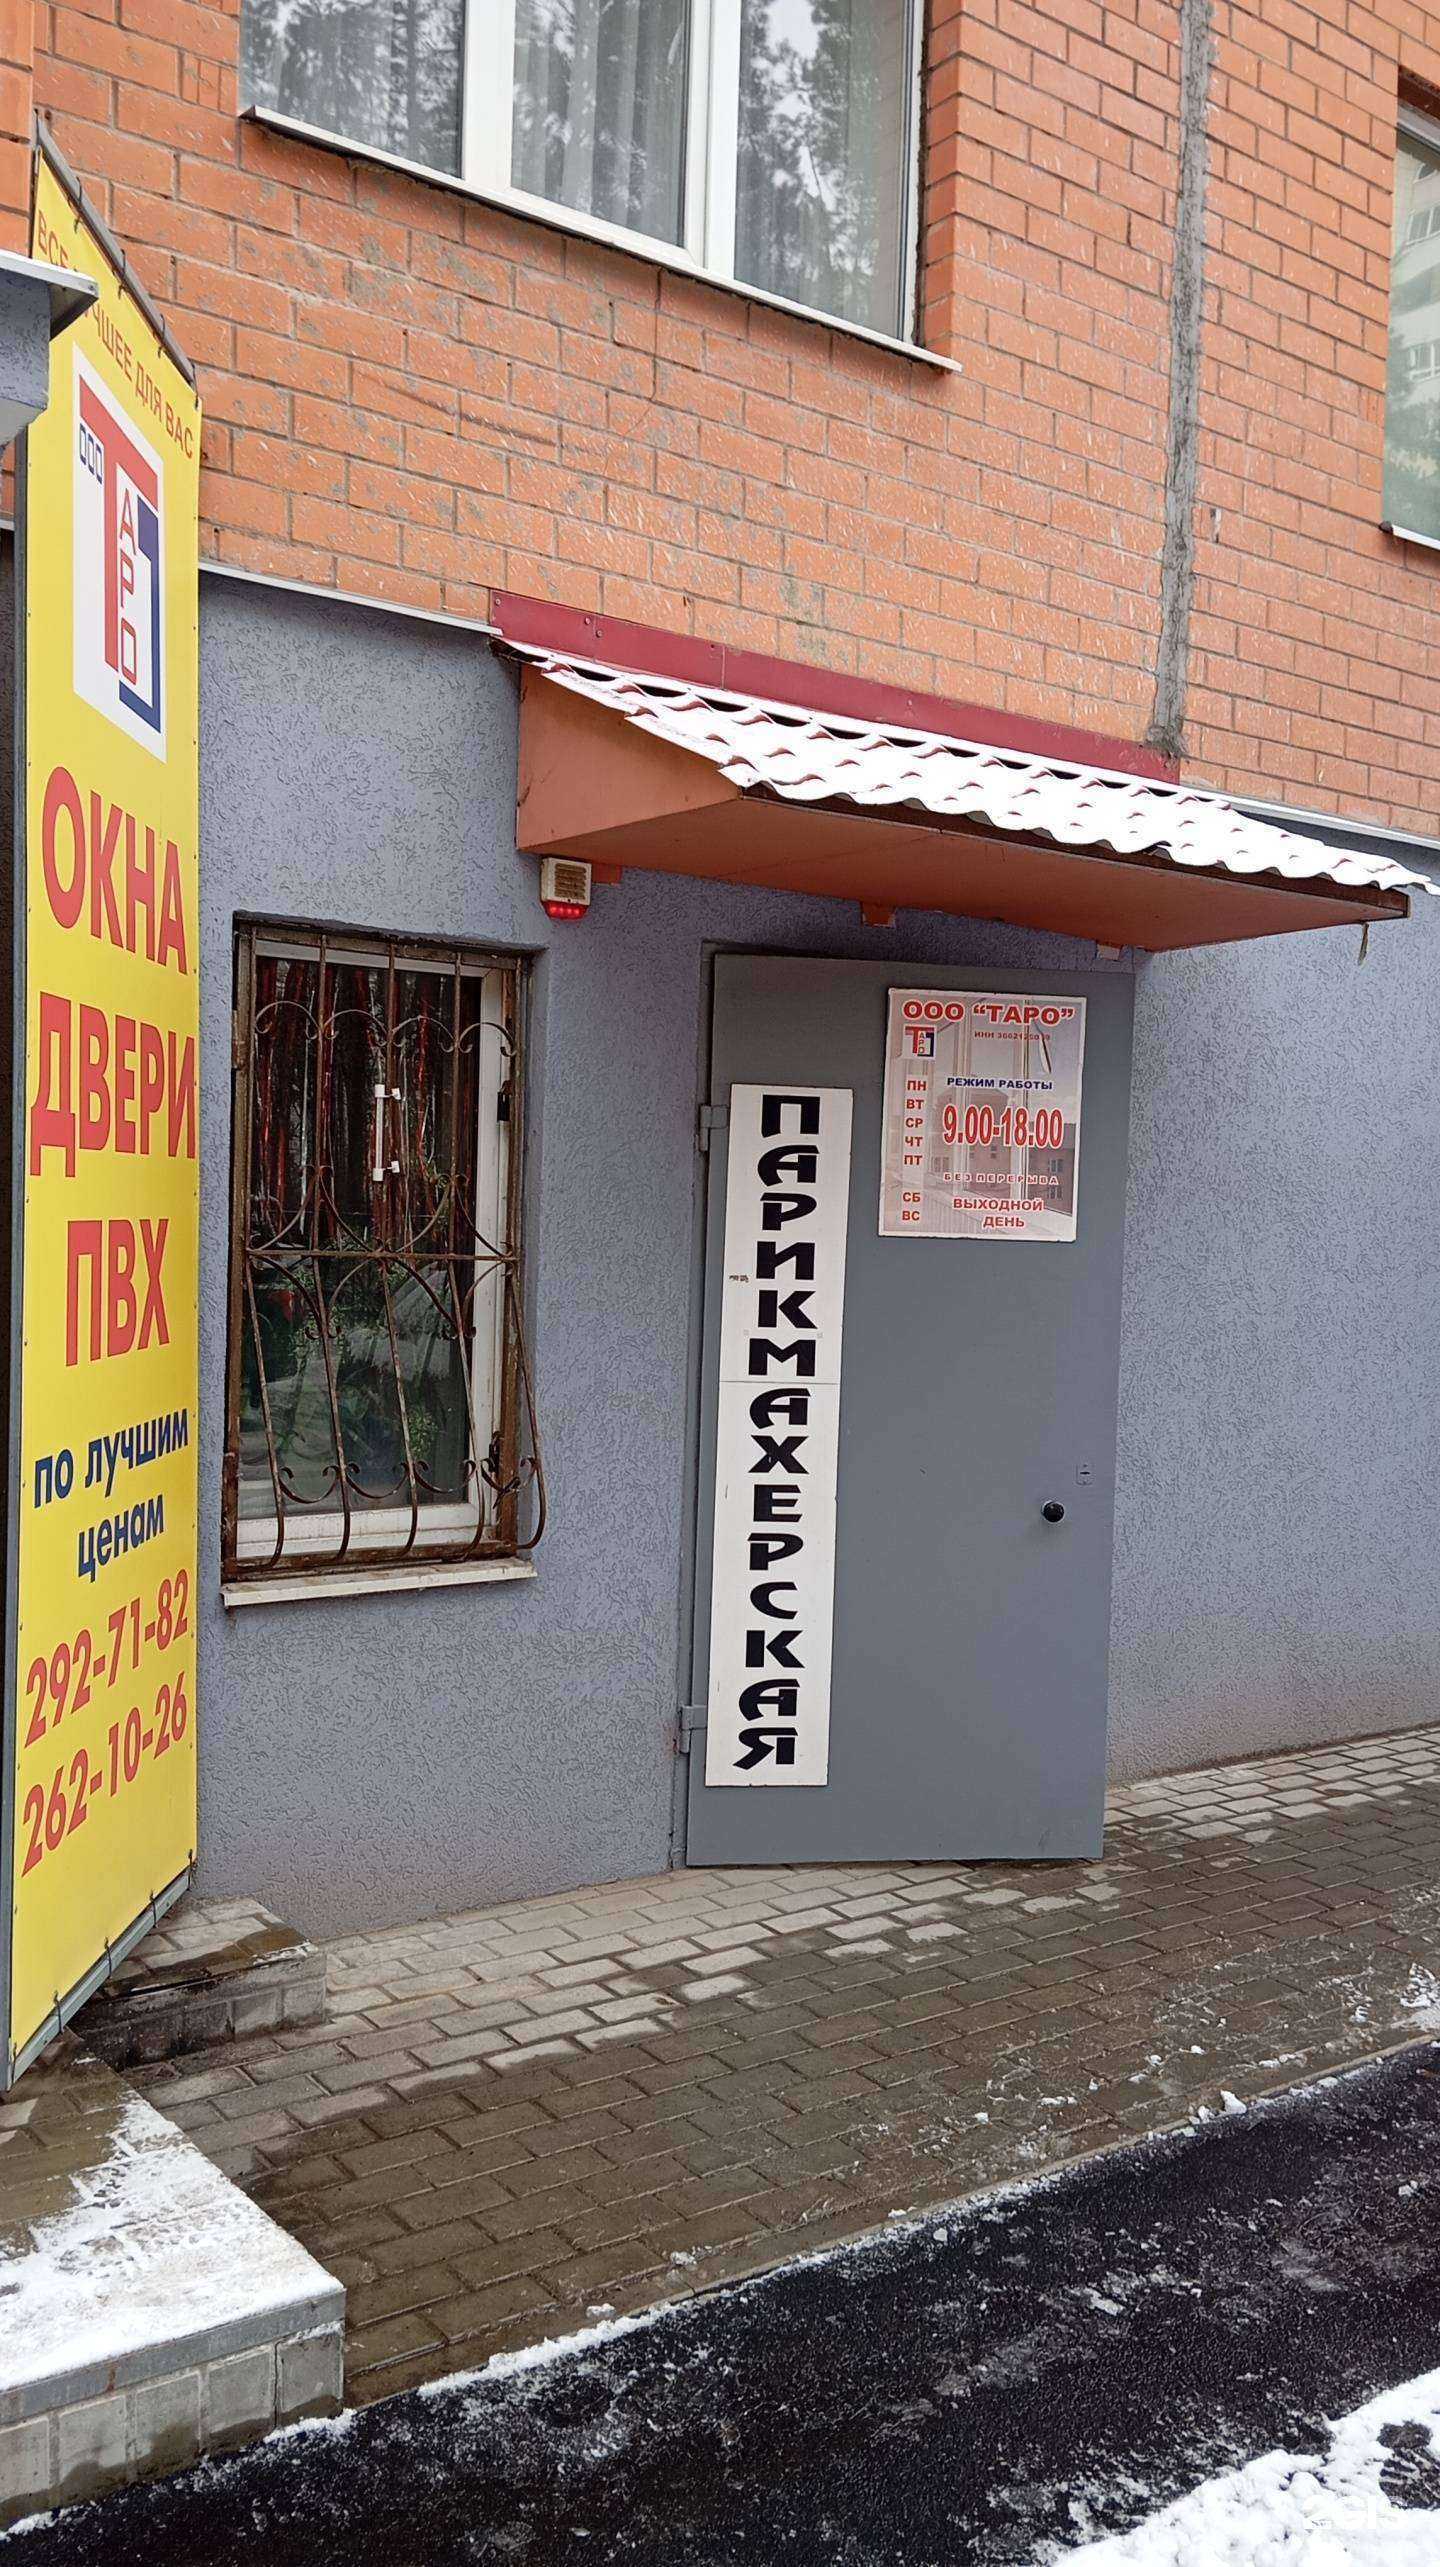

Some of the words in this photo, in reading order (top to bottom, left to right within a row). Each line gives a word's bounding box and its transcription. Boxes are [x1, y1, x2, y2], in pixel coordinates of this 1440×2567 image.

[84, 301, 132, 382] ЧШЕЕ
[136, 361, 162, 423] ДЛЯ
[166, 402, 194, 460] ВАС
[80, 422, 104, 485] ООО
[42, 766, 187, 974] ОКНА
[903, 1001, 964, 1021] ООО
[30, 991, 196, 1178] ДВЕРИ
[907, 1079, 927, 1091] ПН
[947, 1077, 994, 1089] РЕЖИМ
[998, 1079, 1053, 1090] РАБОТЫ
[906, 1099, 924, 1110] ВТ
[905, 1117, 923, 1128] СР
[943, 1104, 1063, 1148] 9.00-18.00
[905, 1136, 923, 1147] ЧТ
[904, 1155, 922, 1166] ПТ
[944, 1172, 971, 1182] БЕЗ
[976, 1174, 1059, 1185] ПЕРЕРЫВА
[902, 1191, 921, 1203] СБ
[953, 1197, 1043, 1211] ВЫХОДНОЙ
[902, 1210, 920, 1221] ВС
[983, 1216, 1025, 1228] ДЕНЬ
[66, 1219, 169, 1367] ПВХ
[732, 1094, 821, 1769] ПАРИКМАХЕРСКАЯ
[78, 1493, 165, 1582] ценам
[24, 1568, 190, 1749] 292-71-82
[21, 1670, 188, 1878] 262-10-26
